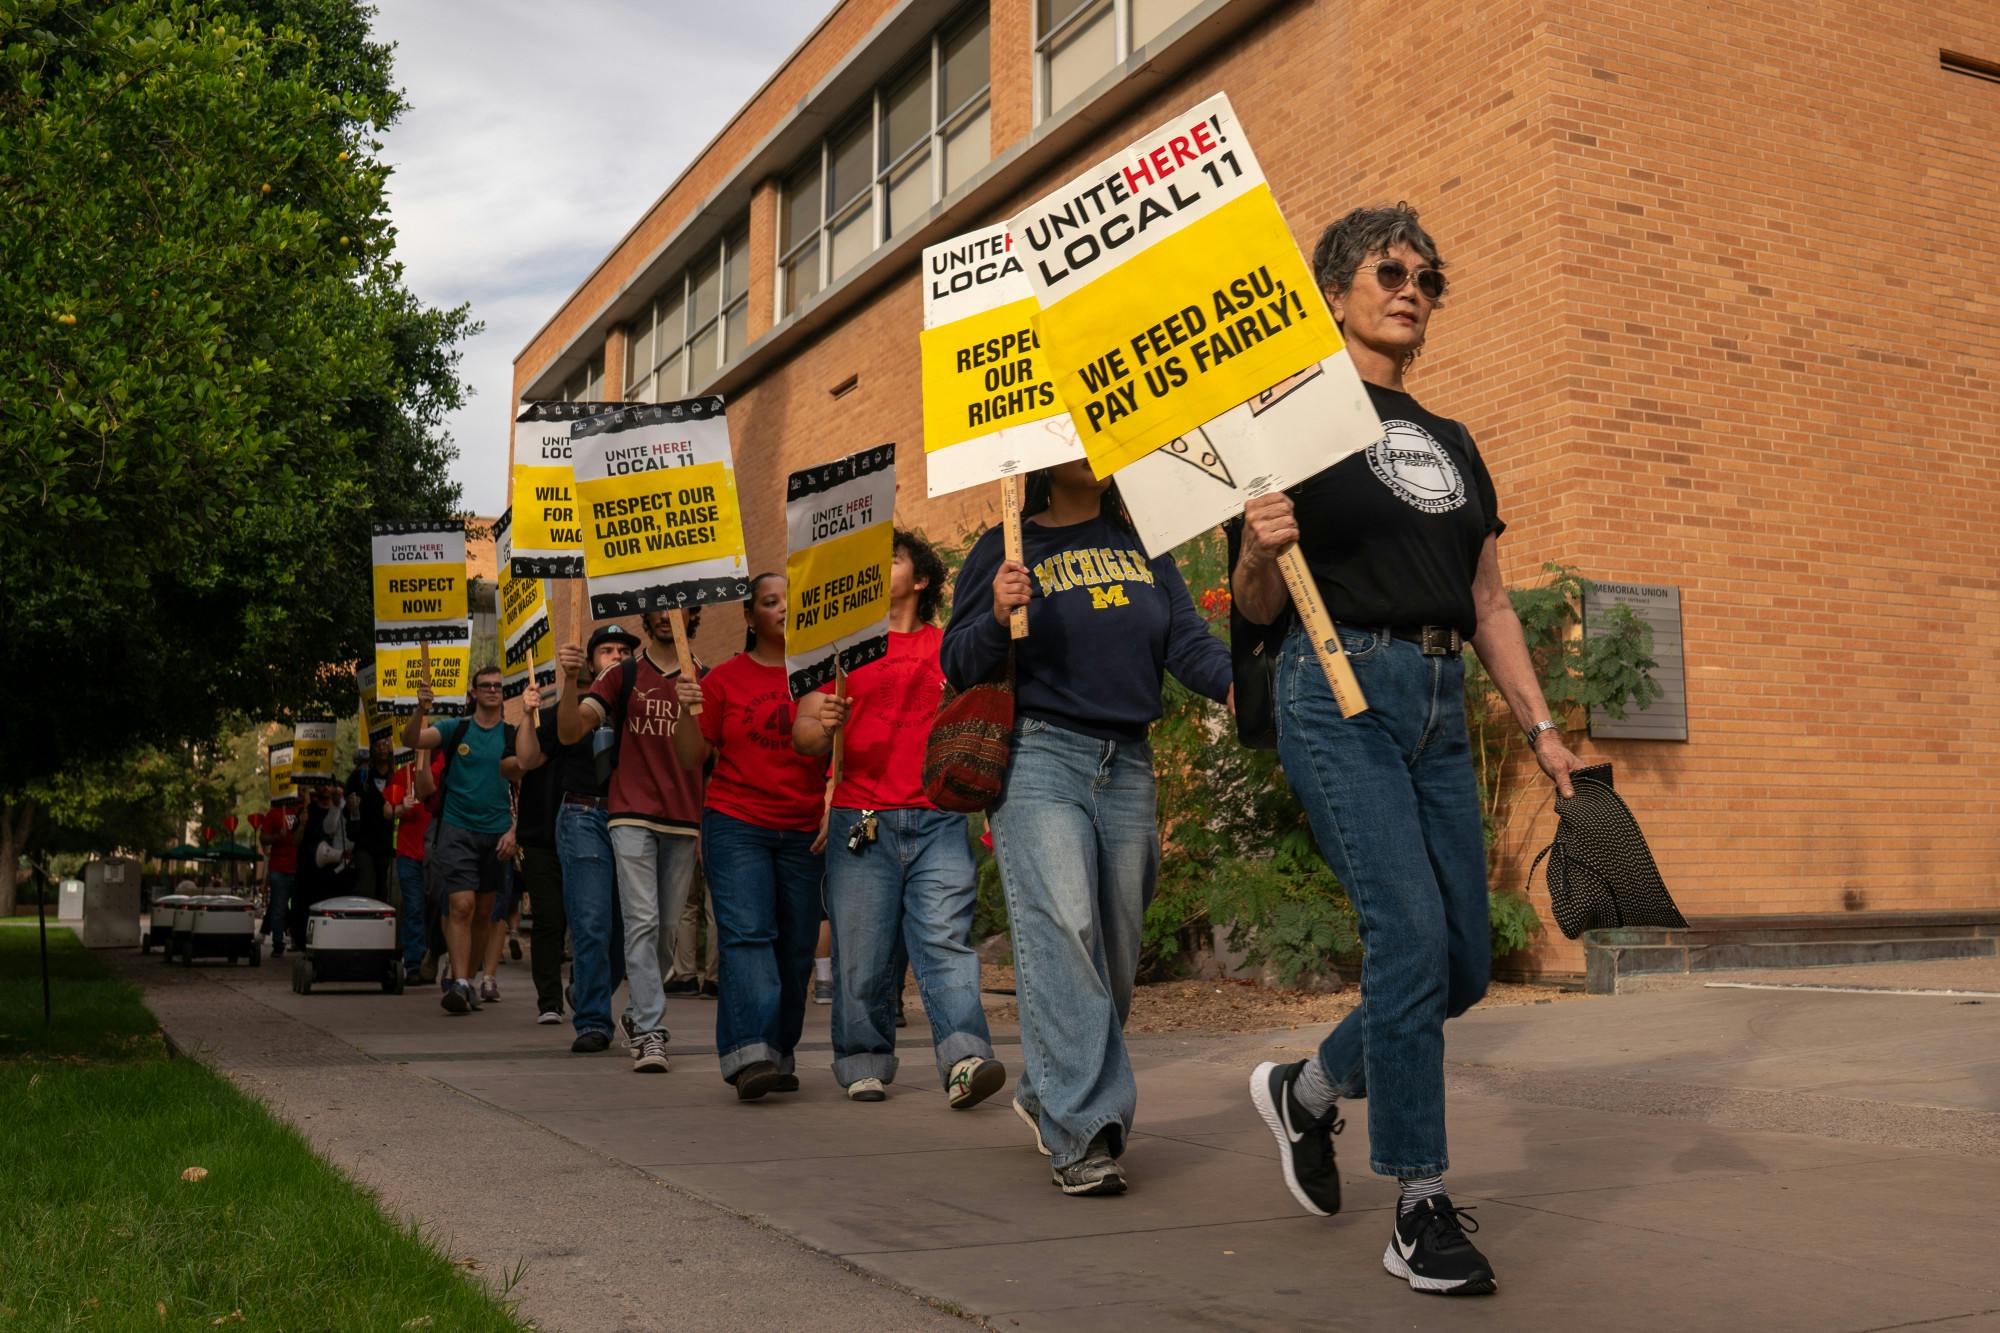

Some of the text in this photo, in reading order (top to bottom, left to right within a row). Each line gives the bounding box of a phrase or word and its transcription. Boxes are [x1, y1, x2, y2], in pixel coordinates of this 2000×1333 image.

[1039, 150, 1243, 287] LOCAL 11
[932, 256, 1024, 300] LOCA
[1078, 265, 1287, 394] WE FEED ASU,
[1085, 290, 1308, 433] PAY US FAIRLY!
[984, 358, 1033, 392] OUR
[968, 381, 1055, 428] RIGHTS
[605, 440, 693, 462] UNITE HERE!
[606, 453, 695, 477] LOCAL 11
[535, 487, 572, 501] WILL
[592, 486, 716, 520] RESPECT OUR
[543, 507, 573, 522] FOR
[812, 494, 873, 525] UNITE HERE!
[595, 505, 720, 540] LABOR, RAISE
[811, 508, 873, 542] LOCAL 11
[391, 543, 444, 552] UNITE HERE!
[604, 526, 717, 559] OUR WAGES!
[391, 551, 444, 561] LOCAL 11
[1033, 547, 1155, 598] MICHIGAN
[389, 577, 455, 593] RESPECT
[801, 563, 881, 609] WE FEED ASU,
[1087, 584, 1130, 609] M
[1594, 583, 1668, 598] MEMORIAL UNION
[402, 599, 442, 613] NOW!
[506, 586, 538, 625] OUR WAGES!
[796, 581, 884, 631] PAY US FAIRLY!
[384, 669, 398, 678] WE
[406, 658, 461, 669] RESCT OUR
[434, 668, 460, 677] RAISE
[382, 679, 398, 687] PAY
[430, 679, 457, 688] AGES!
[299, 748, 328, 757] RESPECT
[302, 760, 321, 769] NOW!
